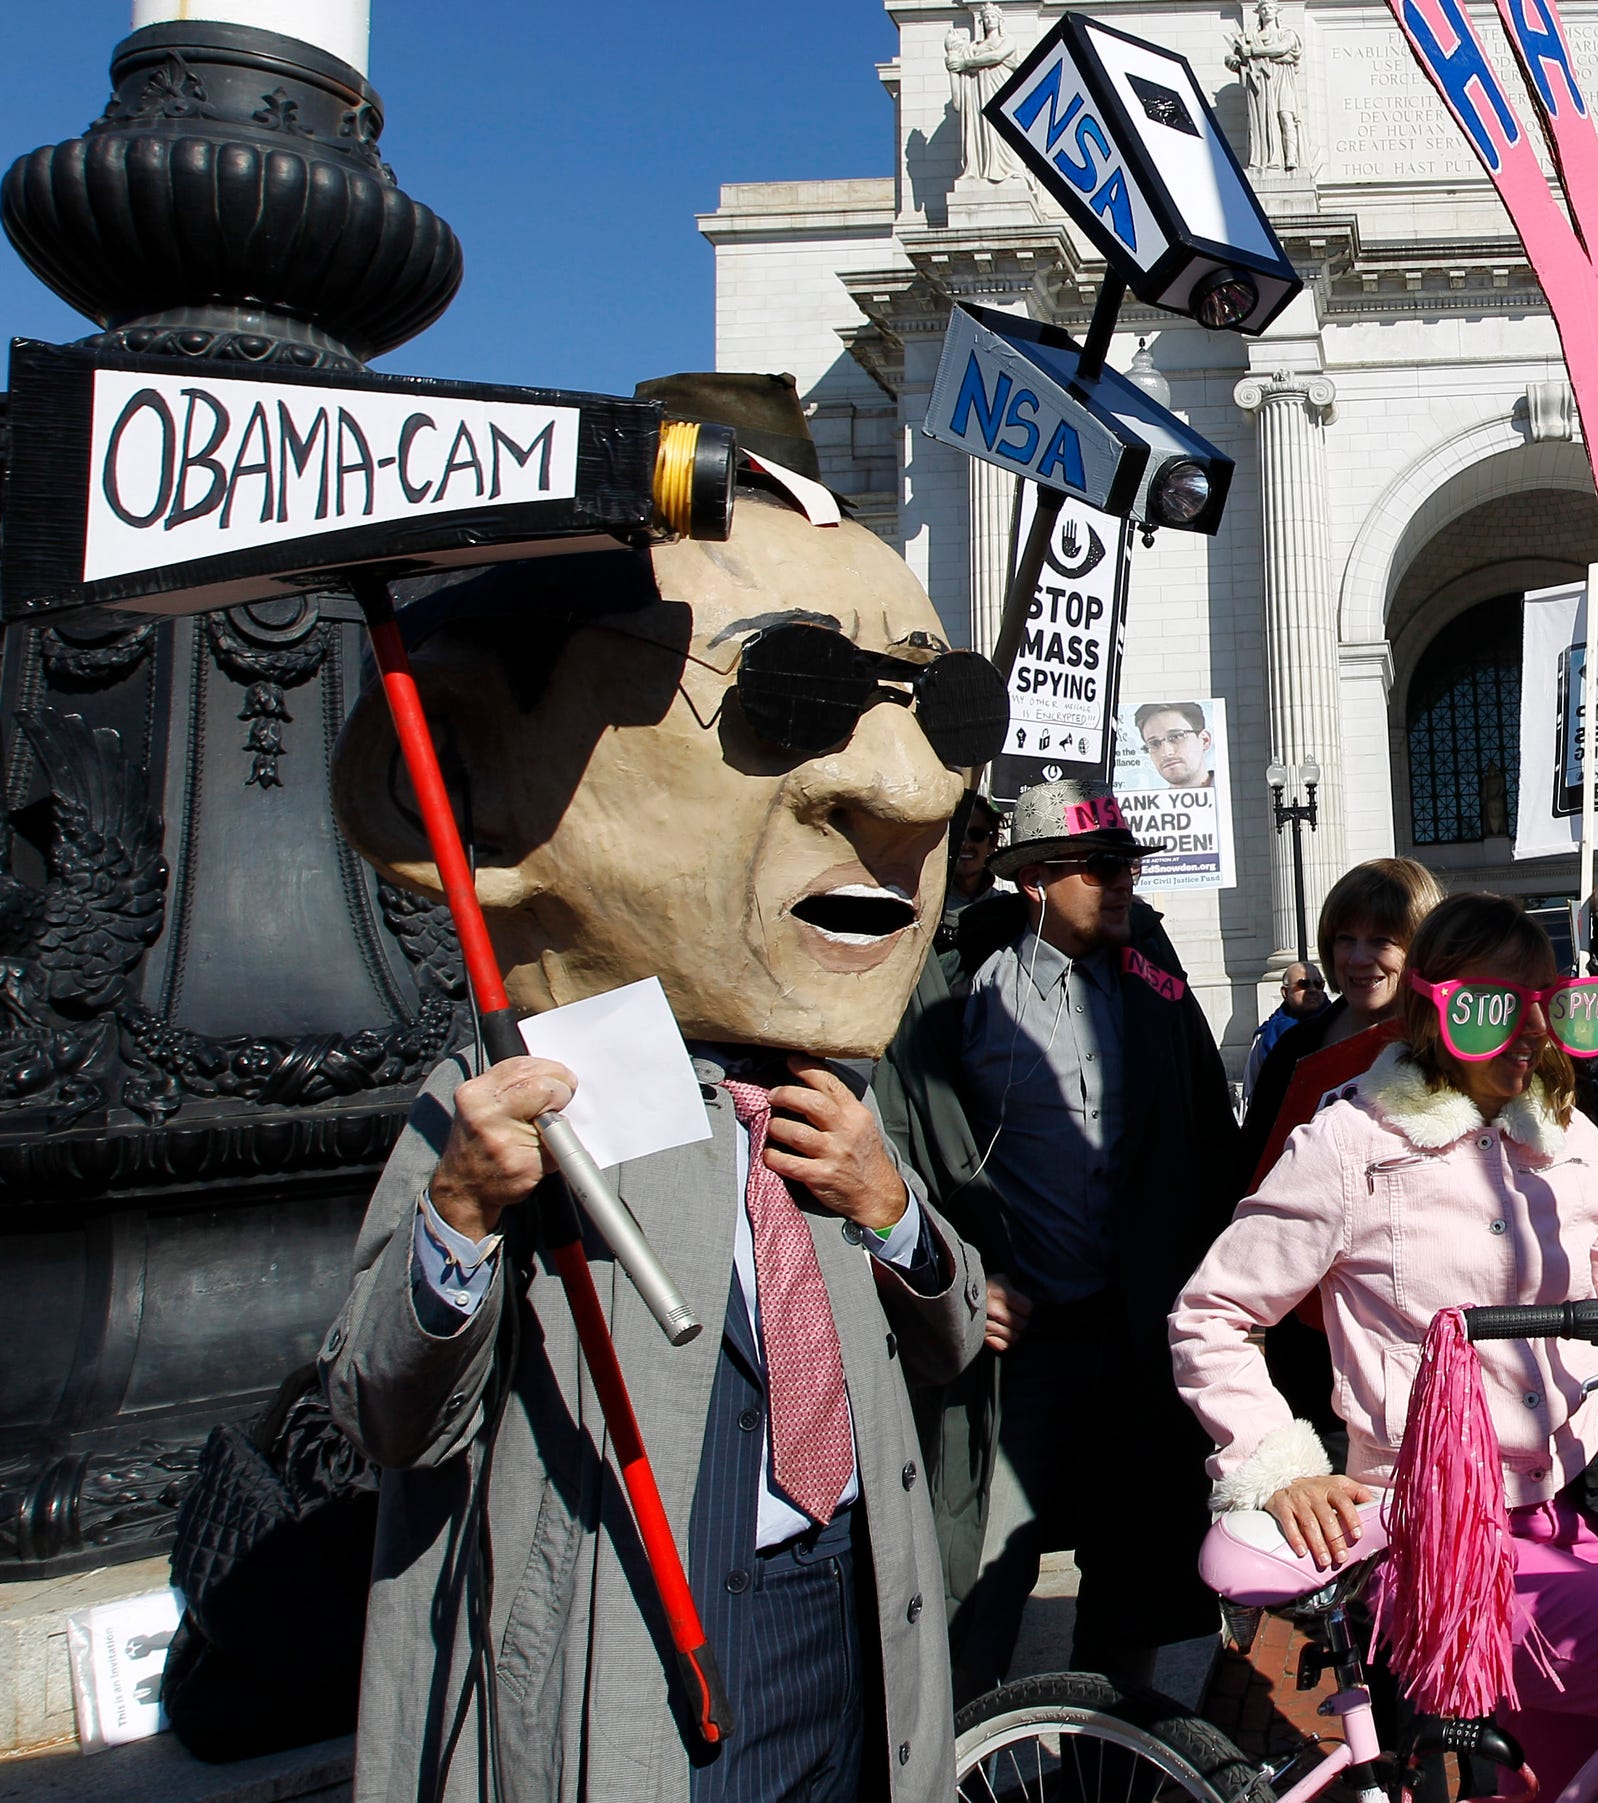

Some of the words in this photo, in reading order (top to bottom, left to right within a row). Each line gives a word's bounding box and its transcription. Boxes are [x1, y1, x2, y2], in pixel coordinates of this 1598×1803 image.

[1373, 60, 1402, 72] USE
[1358, 125, 1377, 137] OF
[1387, 124, 1446, 136] HUMAN
[1360, 110, 1445, 123] DEVOURER
[1013, 57, 1136, 254] NSA
[1336, 140, 1416, 152] GREATEST
[1343, 163, 1384, 175] THOU
[1394, 161, 1435, 174] HAST
[1446, 160, 1474, 172] PUT
[950, 349, 1086, 493] NSA
[103, 387, 556, 531] OBAMA-CAM
[1027, 584, 1103, 630] STOP
[1018, 627, 1100, 671] MASS
[1016, 666, 1097, 703] SPYING
[1121, 795, 1160, 811] ANK
[1168, 792, 1212, 808] YOU,
[1125, 813, 1191, 833] WARD
[1129, 951, 1176, 1000] NSA
[1452, 991, 1517, 1027] STOP
[117, 1705, 128, 1728] This
